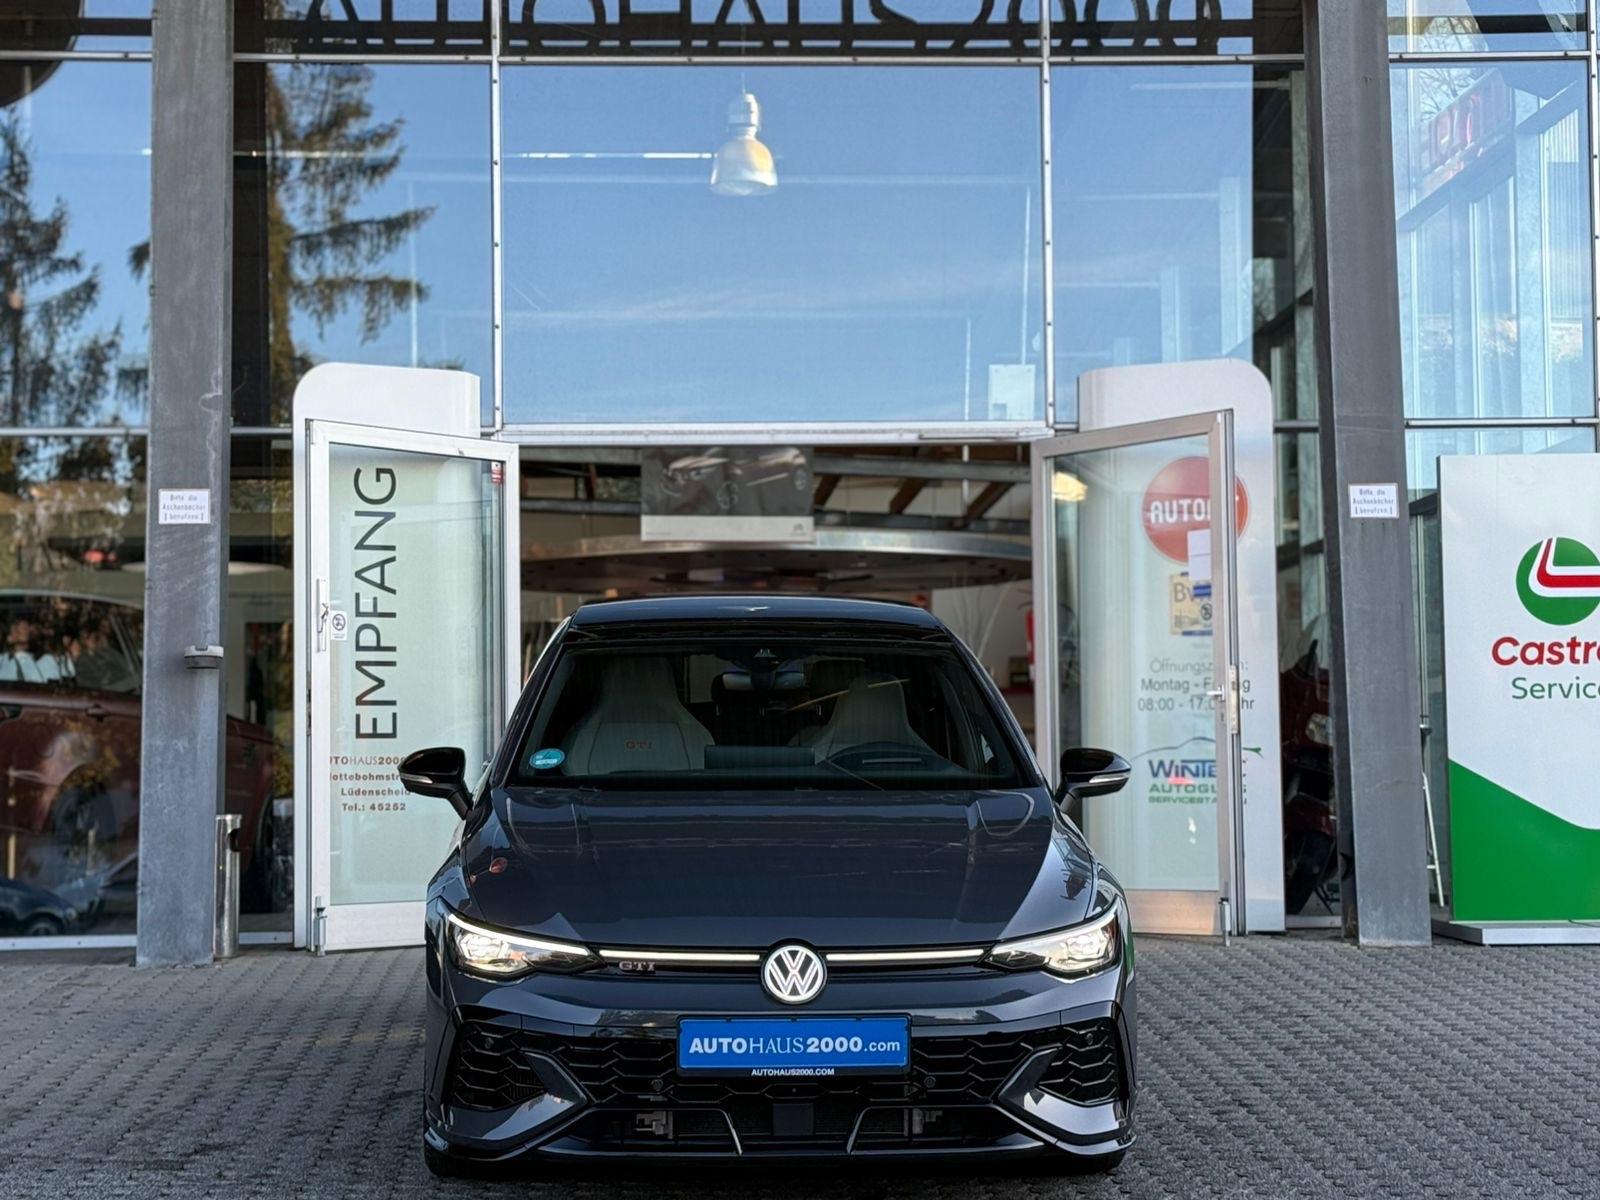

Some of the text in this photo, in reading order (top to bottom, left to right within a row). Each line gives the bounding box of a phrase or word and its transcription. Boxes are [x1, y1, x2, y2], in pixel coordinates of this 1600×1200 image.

[353, 467, 397, 739] EMPFANG
[1491, 635, 1600, 666] Castr
[1140, 679, 1190, 693] Montag
[1511, 675, 1600, 699] Servic
[1137, 697, 1174, 711] 08:00
[1241, 697, 1254, 710] hr
[329, 773, 400, 781] ottebohmstr
[618, 960, 655, 972] GTI
[750, 1068, 835, 1077] AUTOHAUS2000.COM
